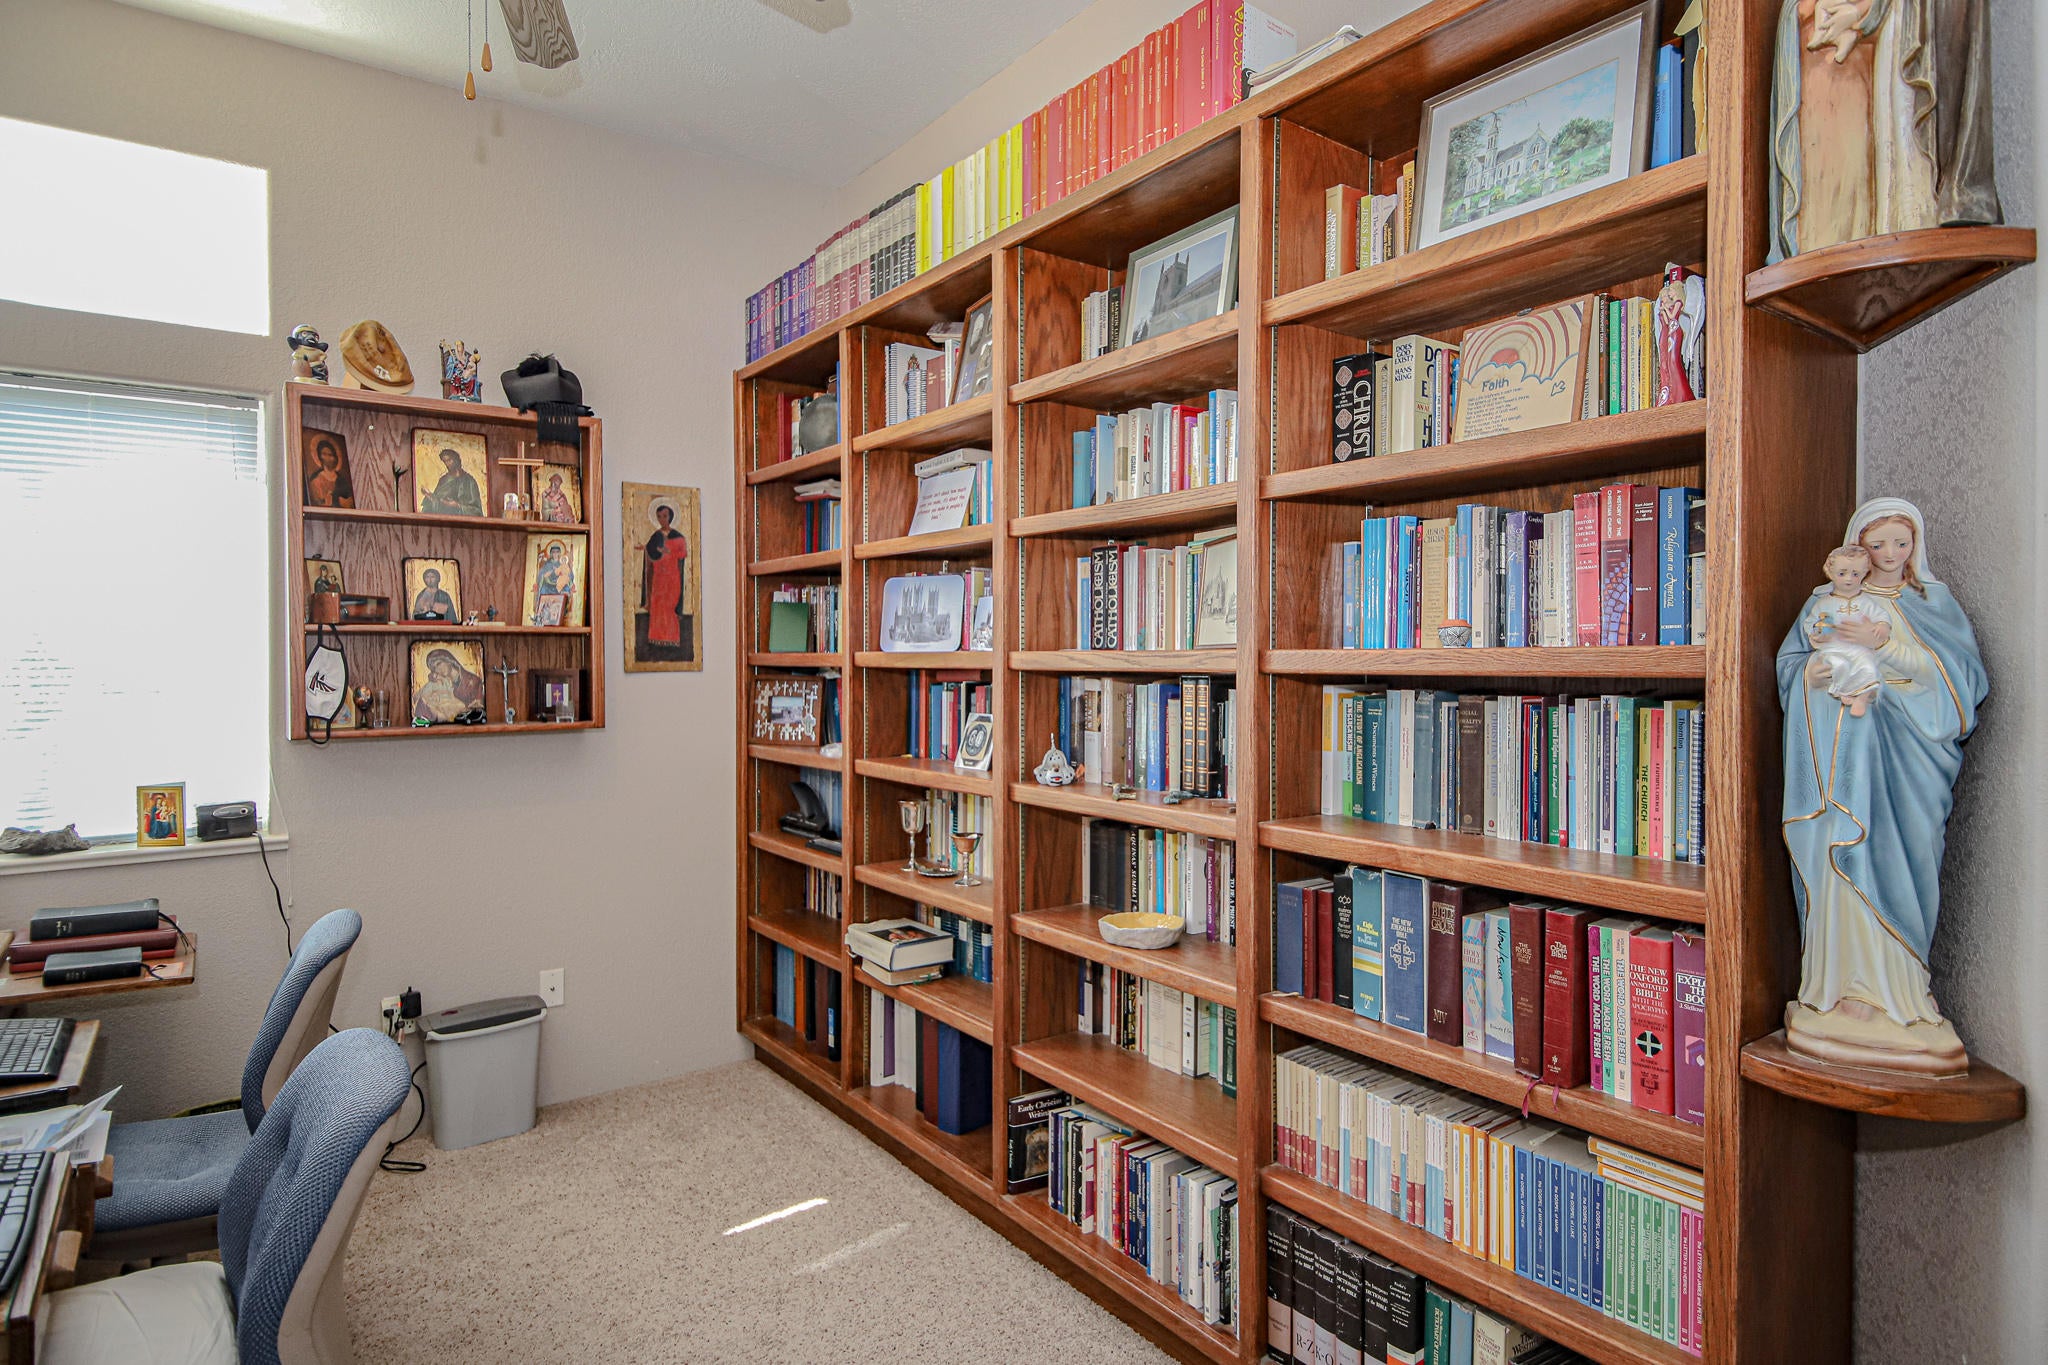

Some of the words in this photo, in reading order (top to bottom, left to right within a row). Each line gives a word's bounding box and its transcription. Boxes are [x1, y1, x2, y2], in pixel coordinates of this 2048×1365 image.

[1396, 343, 1412, 352] DOES
[1397, 350, 1411, 358] GOD
[1395, 355, 1414, 365] EXIST?
[1396, 366, 1412, 375] HANS
[1481, 377, 1509, 392] Faith
[1353, 380, 1371, 457] CHRIST
[1616, 518, 1622, 526] OF
[1664, 527, 1680, 562] Religion
[1664, 573, 1678, 609] America
[1620, 708, 1630, 734] Faith
[1356, 736, 1363, 744] OF
[1620, 735, 1628, 746] in
[1372, 758, 1379, 766] of
[1620, 748, 1628, 762] the
[1618, 764, 1628, 830] Countryside
[1432, 906, 1455, 920] BIBLE
[1392, 916, 1401, 924] THE
[1401, 919, 1412, 927] NEW
[1391, 924, 1414, 934] JERUSALEM
[1396, 931, 1408, 939] BIBLE
[1550, 944, 1568, 954] Open
[1555, 941, 1567, 950] The
[1464, 948, 1480, 958] HOLY
[1464, 954, 1481, 965] BIBLE
[1552, 952, 1568, 960] Bible
[1592, 956, 1600, 972] THE
[1602, 958, 1610, 976] THE
[1616, 959, 1626, 977] THE
[1630, 964, 1646, 972] THE
[1648, 966, 1668, 976] NEW
[1630, 972, 1668, 986] OXFORD
[1630, 980, 1668, 992] ANNOTATED
[1592, 974, 1600, 1002] WORD
[1602, 977, 1611, 1004] WORD
[1616, 978, 1626, 1006] WORD
[1636, 988, 1662, 1000] BIBLE
[1632, 996, 1652, 1004] WITH
[1652, 1000, 1664, 1008] THE
[1632, 1004, 1668, 1014] APOCRYPHA
[1434, 1009, 1448, 1024] NIV
[1593, 1002, 1601, 1030] MADE
[1602, 1005, 1612, 1032] MADE
[1617, 1007, 1626, 1036] MADE
[1593, 1032, 1602, 1058] FRESH
[1603, 1034, 1612, 1062] FRESH
[1618, 1036, 1626, 1064] FRESH
[1018, 1103, 1034, 1112] Early
[1036, 1098, 1062, 1109] Christian
[1617, 1150, 1634, 1160] TWELVE
[1634, 1156, 1657, 1168] PROPHETS
[1346, 1289, 1357, 1298] BIBLE
[1390, 1285, 1411, 1298] Commentary
[1296, 1333, 1315, 1354] R-Z
